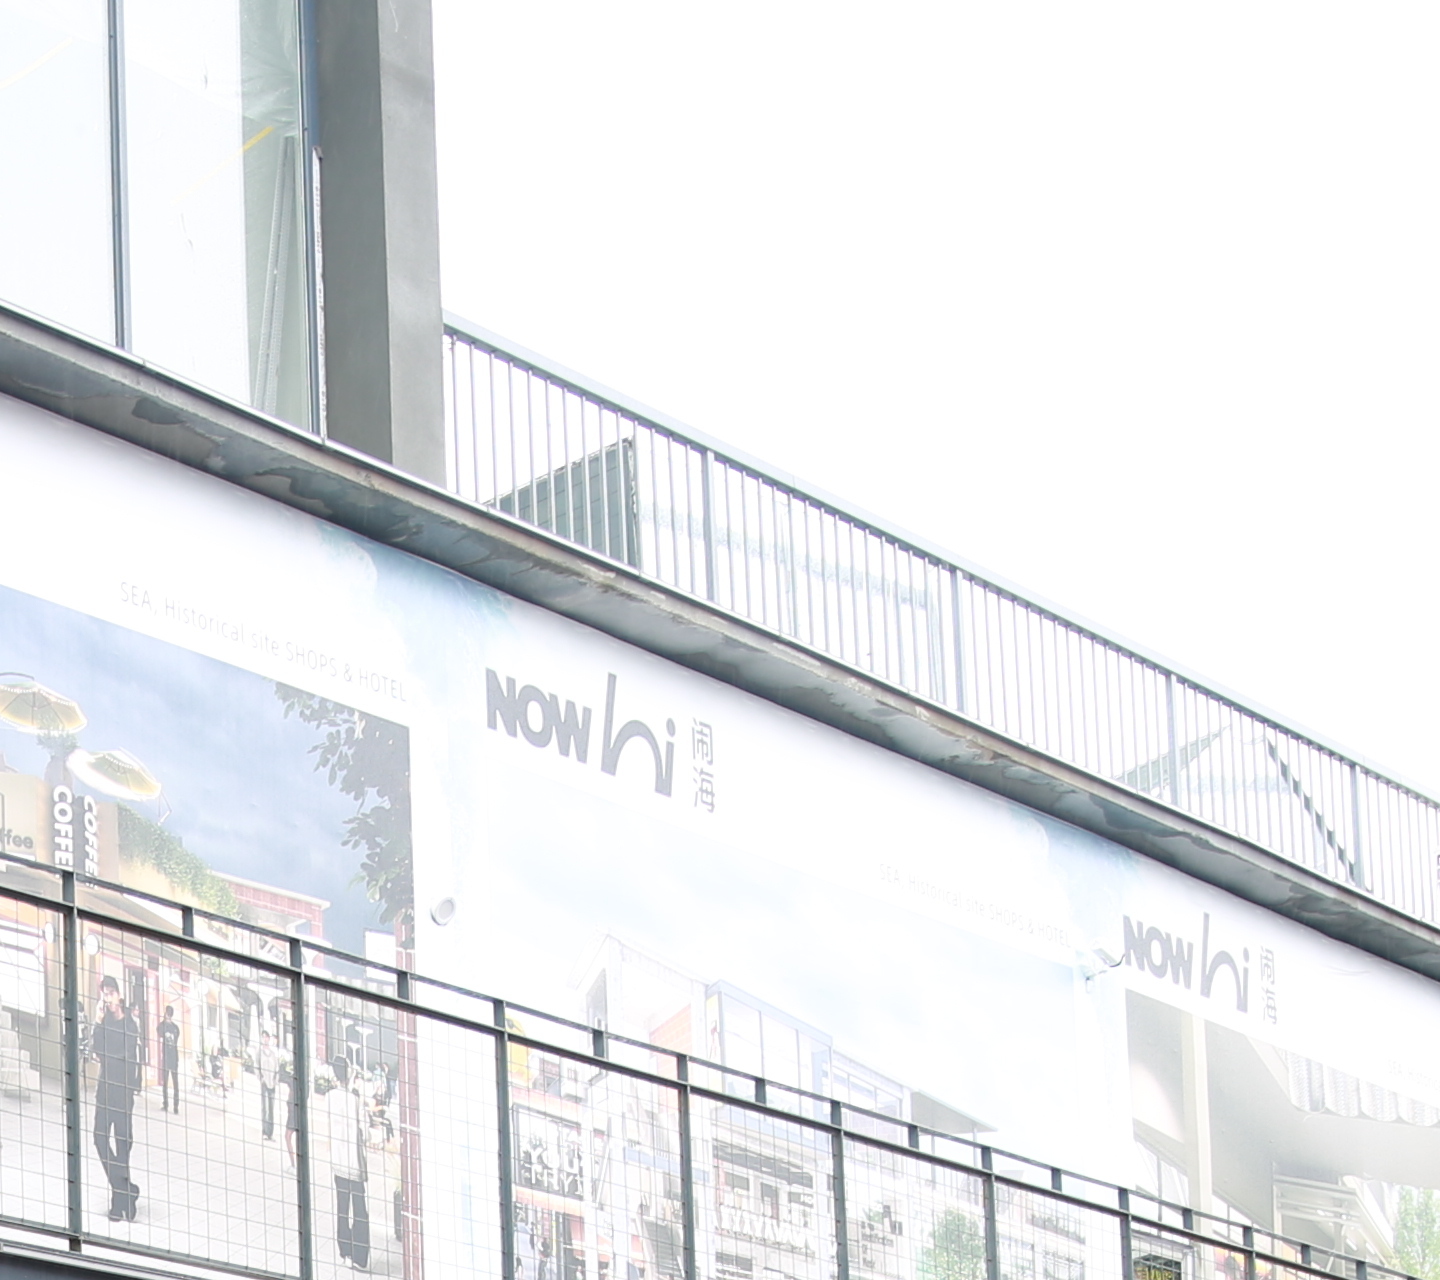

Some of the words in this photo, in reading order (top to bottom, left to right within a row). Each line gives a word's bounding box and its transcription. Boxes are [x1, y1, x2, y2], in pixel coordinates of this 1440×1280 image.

[121, 581, 158, 616] SEA,
[164, 597, 244, 645] Historical
[251, 629, 279, 657] site
[285, 641, 337, 677] SHOPS
[343, 662, 353, 683] &
[358, 667, 407, 702] HOTEL
[485, 667, 593, 763] NOW
[690, 716, 717, 813] 闹海
[1123, 914, 1195, 991] NOW
[1260, 945, 1279, 1026] 闹海
